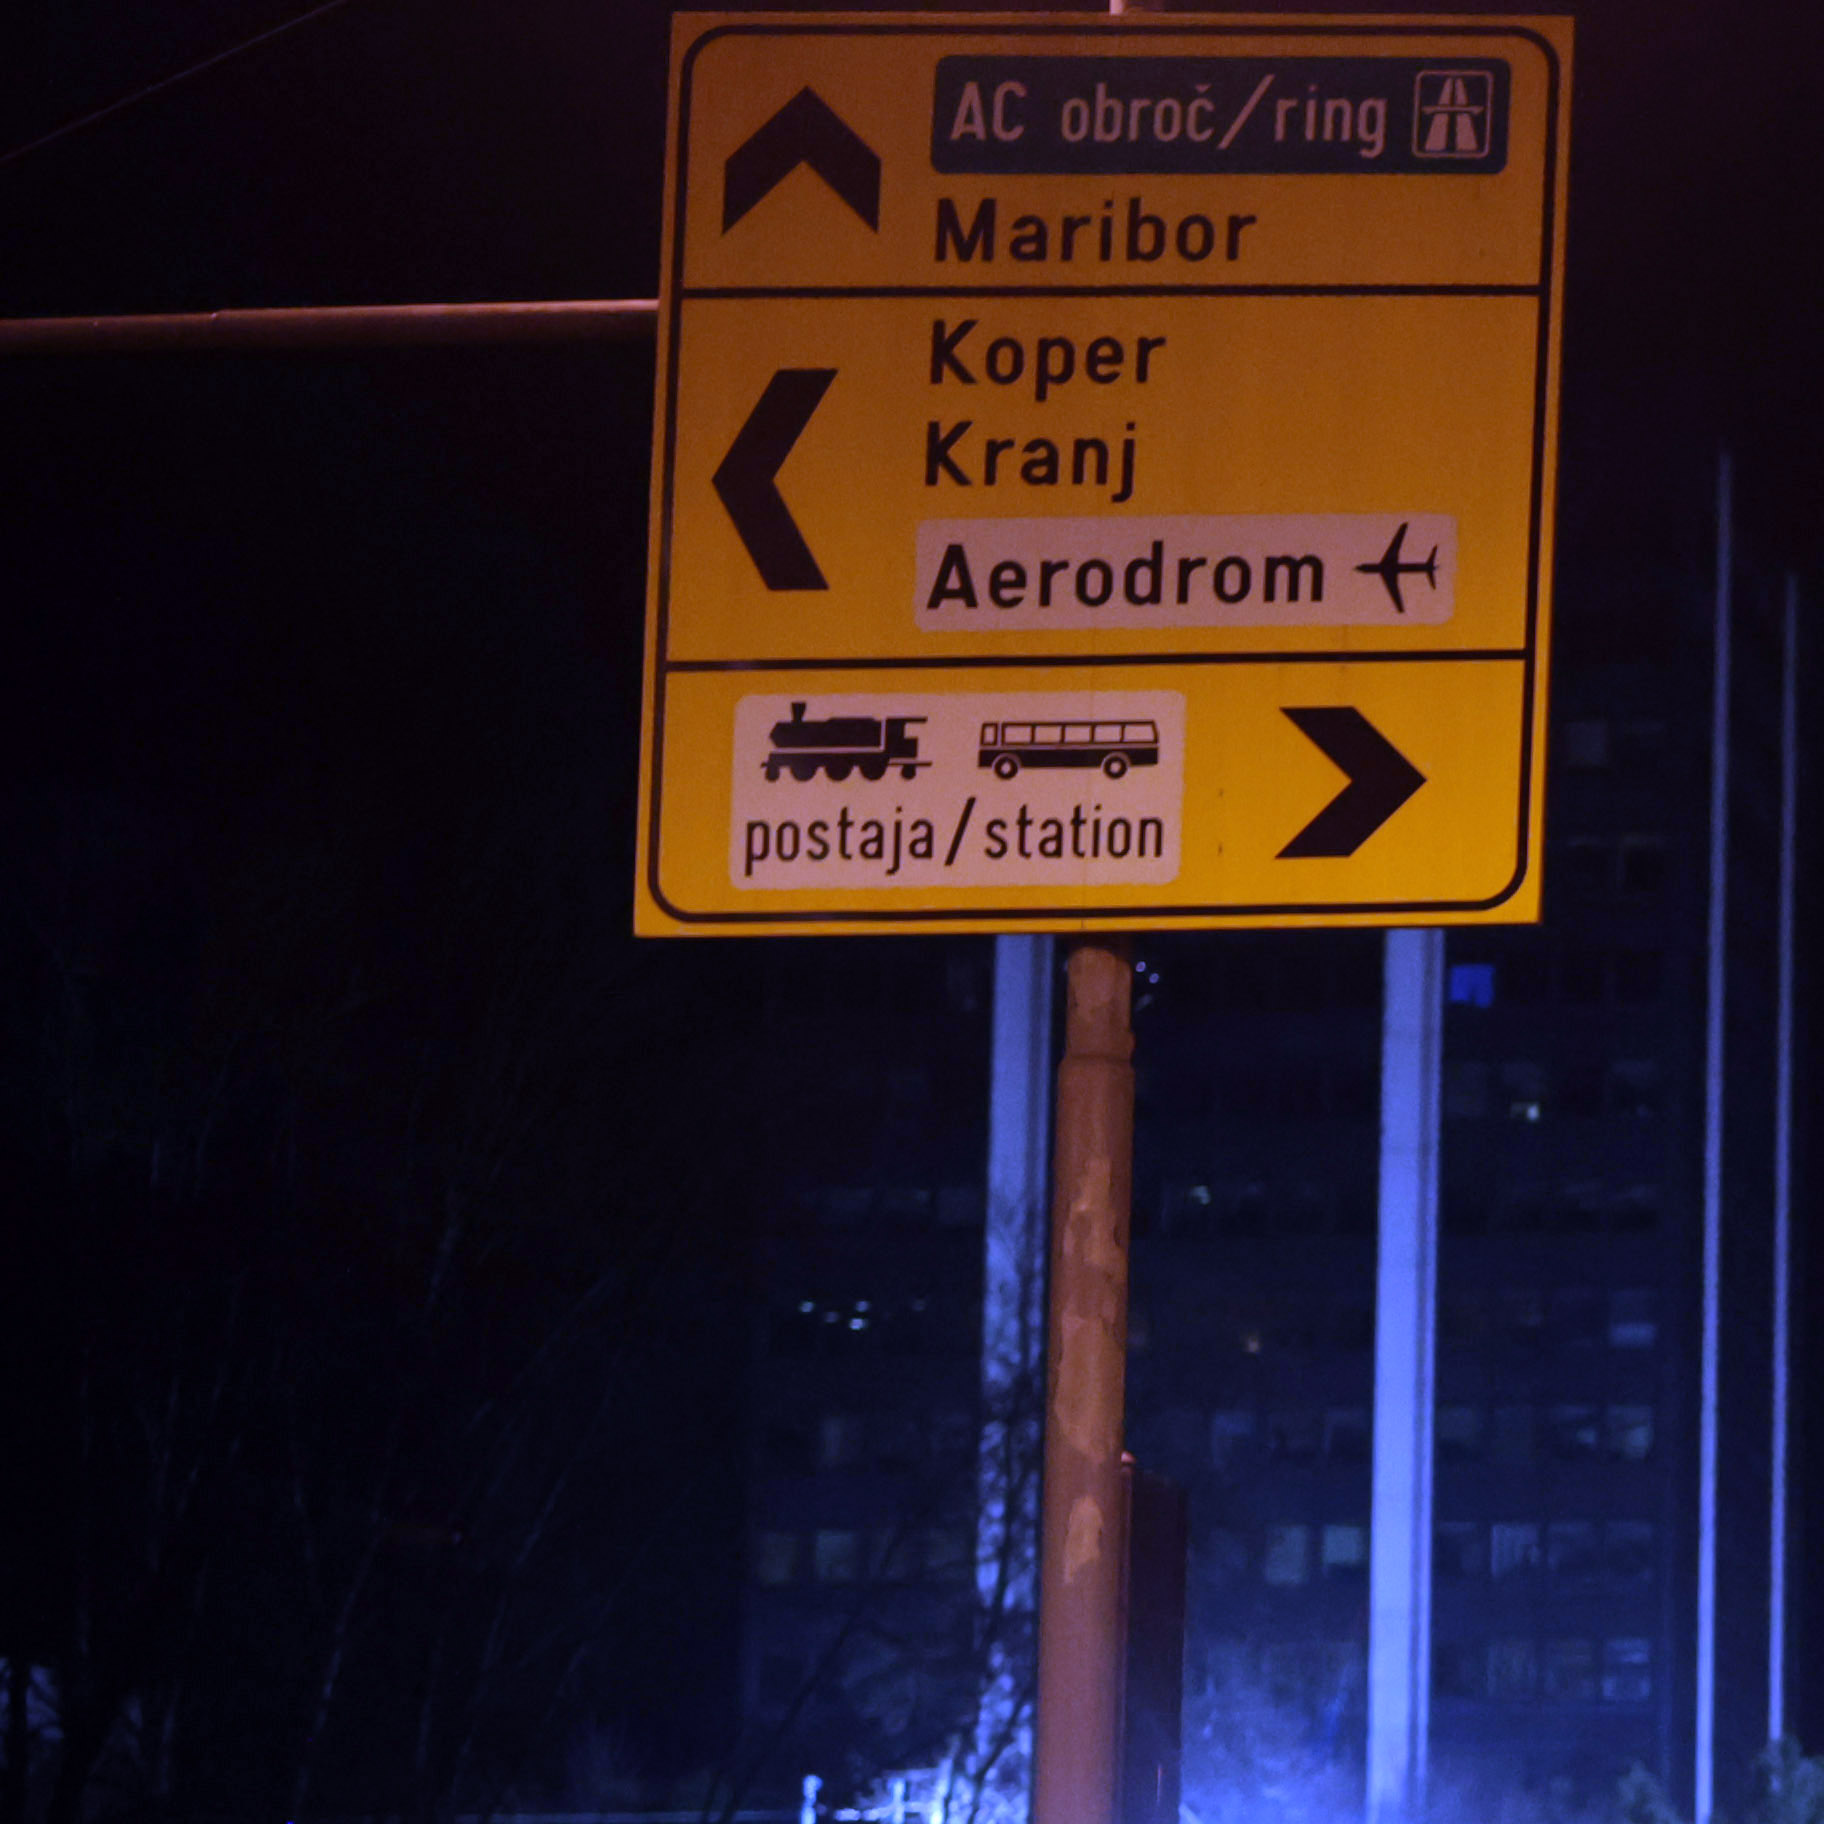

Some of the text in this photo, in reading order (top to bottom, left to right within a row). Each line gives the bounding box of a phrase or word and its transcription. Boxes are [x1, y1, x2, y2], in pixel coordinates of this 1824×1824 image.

[949, 74, 1388, 157] AC obroč/ring
[934, 197, 1256, 262] Maribor
[929, 318, 1166, 400] Koper
[924, 420, 1138, 502] Kranj
[926, 541, 1325, 609] Aerodrom
[744, 796, 1164, 876] postaja/station
